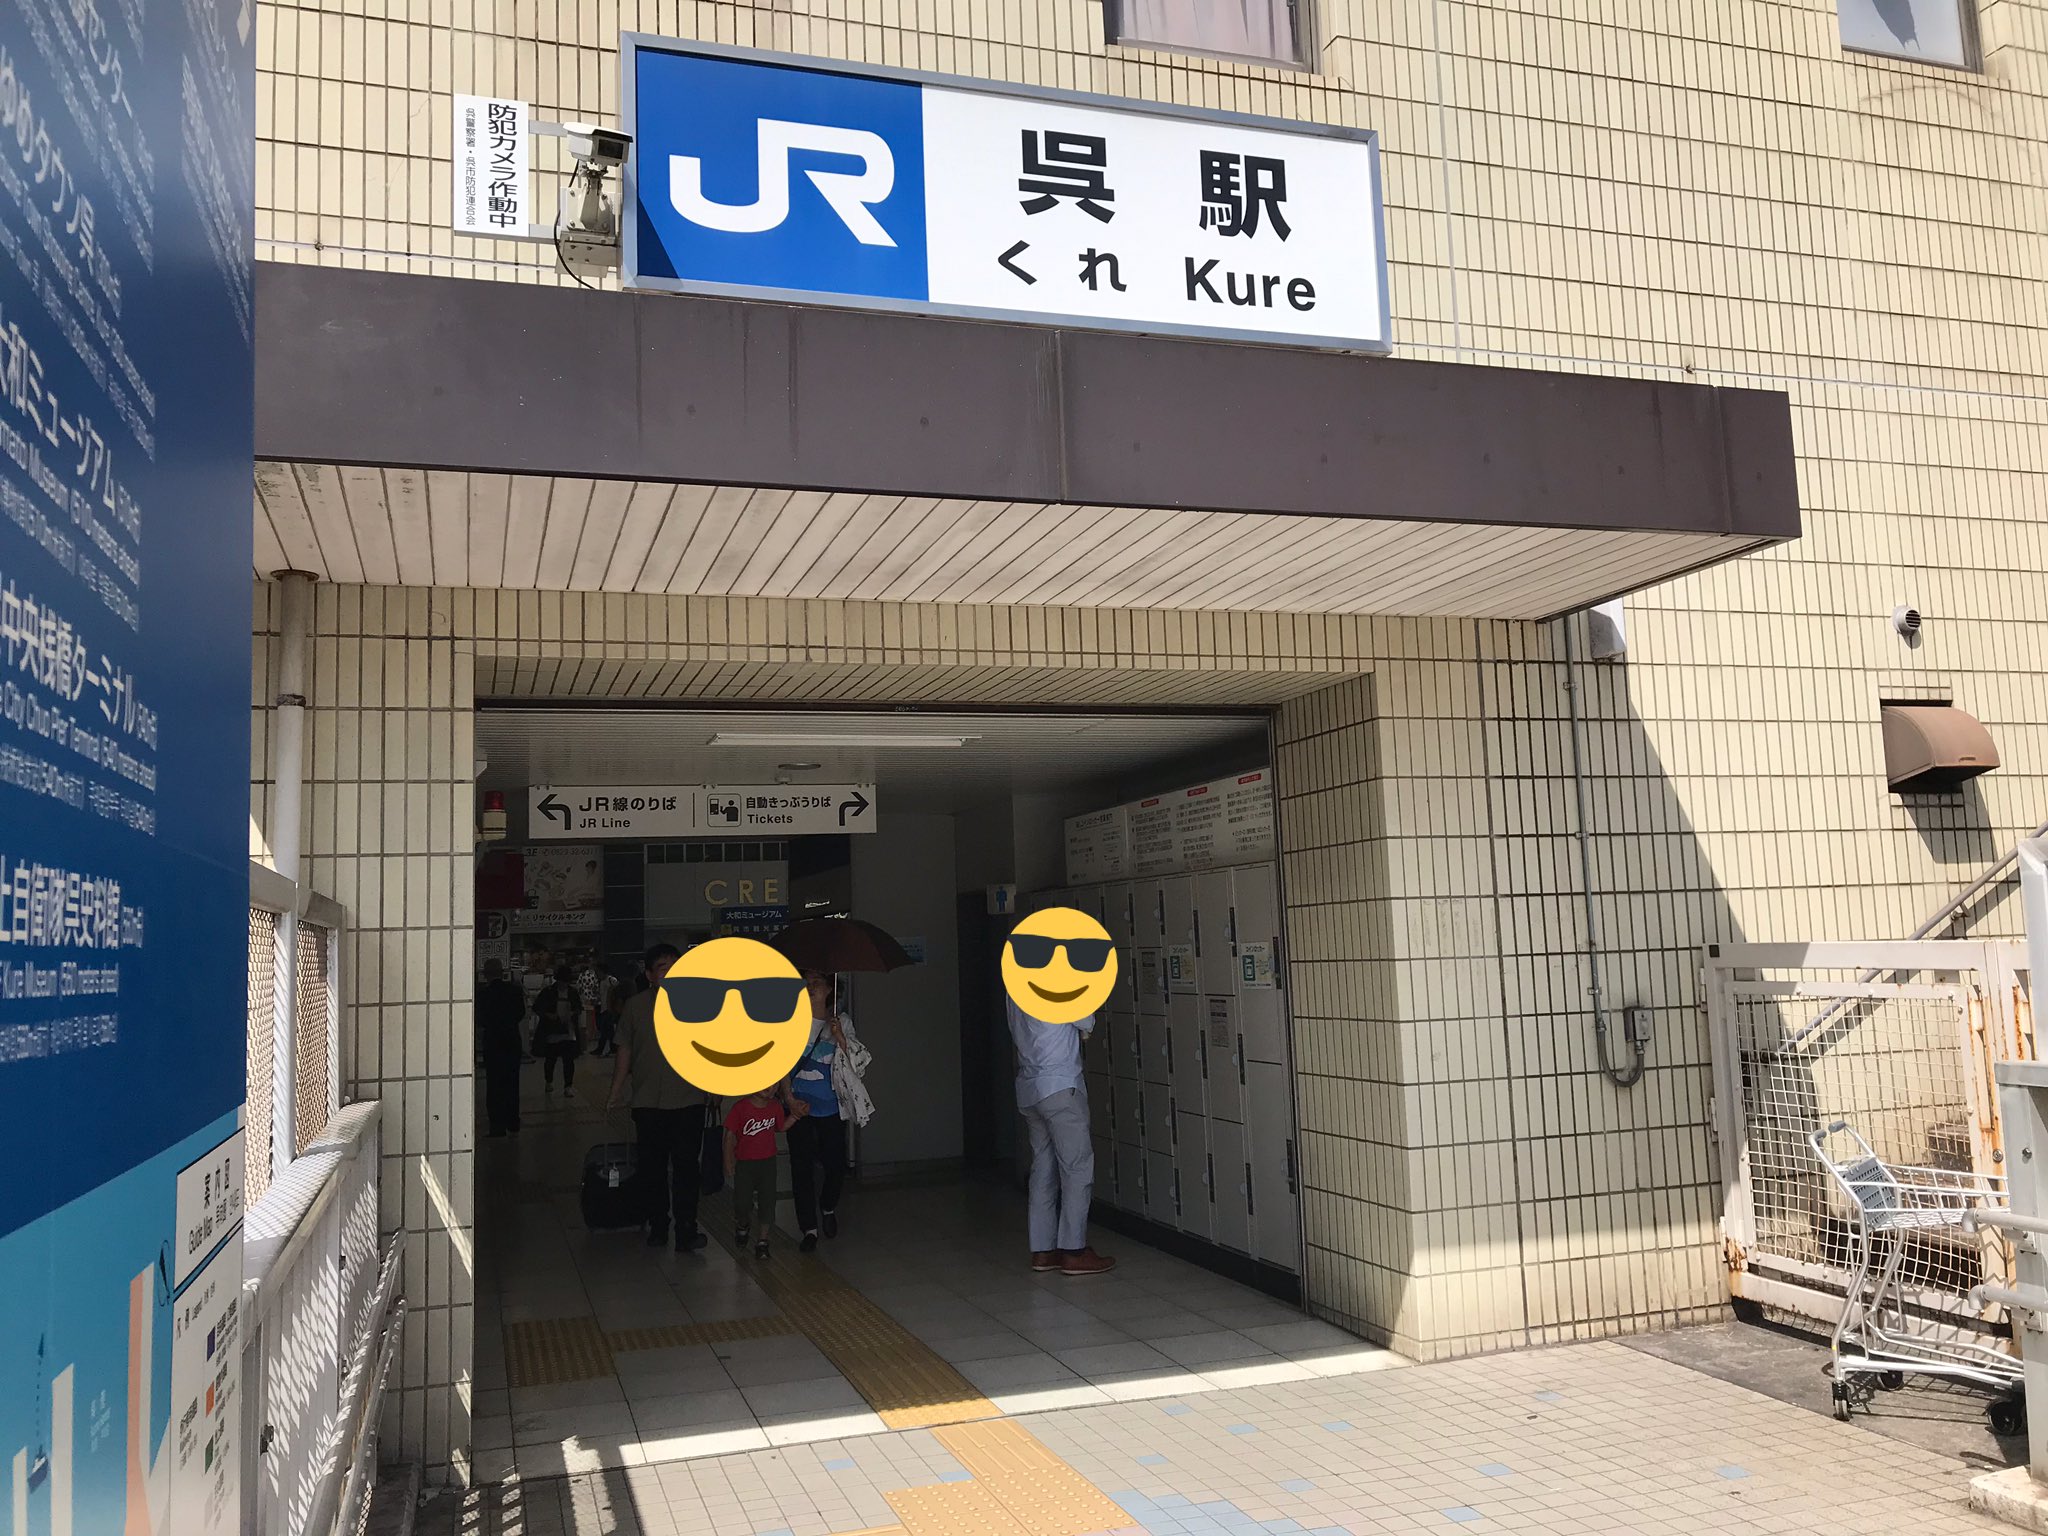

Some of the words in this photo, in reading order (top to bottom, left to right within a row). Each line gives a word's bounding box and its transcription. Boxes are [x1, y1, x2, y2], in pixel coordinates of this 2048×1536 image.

[488, 103, 518, 228] 防犯カメラ作動中
[669, 117, 898, 247] JR
[1018, 129, 1291, 243] 呉駅
[997, 241, 1128, 292] くれ
[1184, 256, 1316, 311] Kure
[579, 796, 677, 812] JR線のりば
[746, 796, 832, 809] 自動きっぷうりば
[579, 817, 597, 828] JR
[601, 817, 631, 829] Line
[747, 813, 793, 824] Tickets
[704, 879, 779, 906] CRE
[726, 910, 782, 920] 大和ミュージアム
[743, 1117, 775, 1135] Carp
